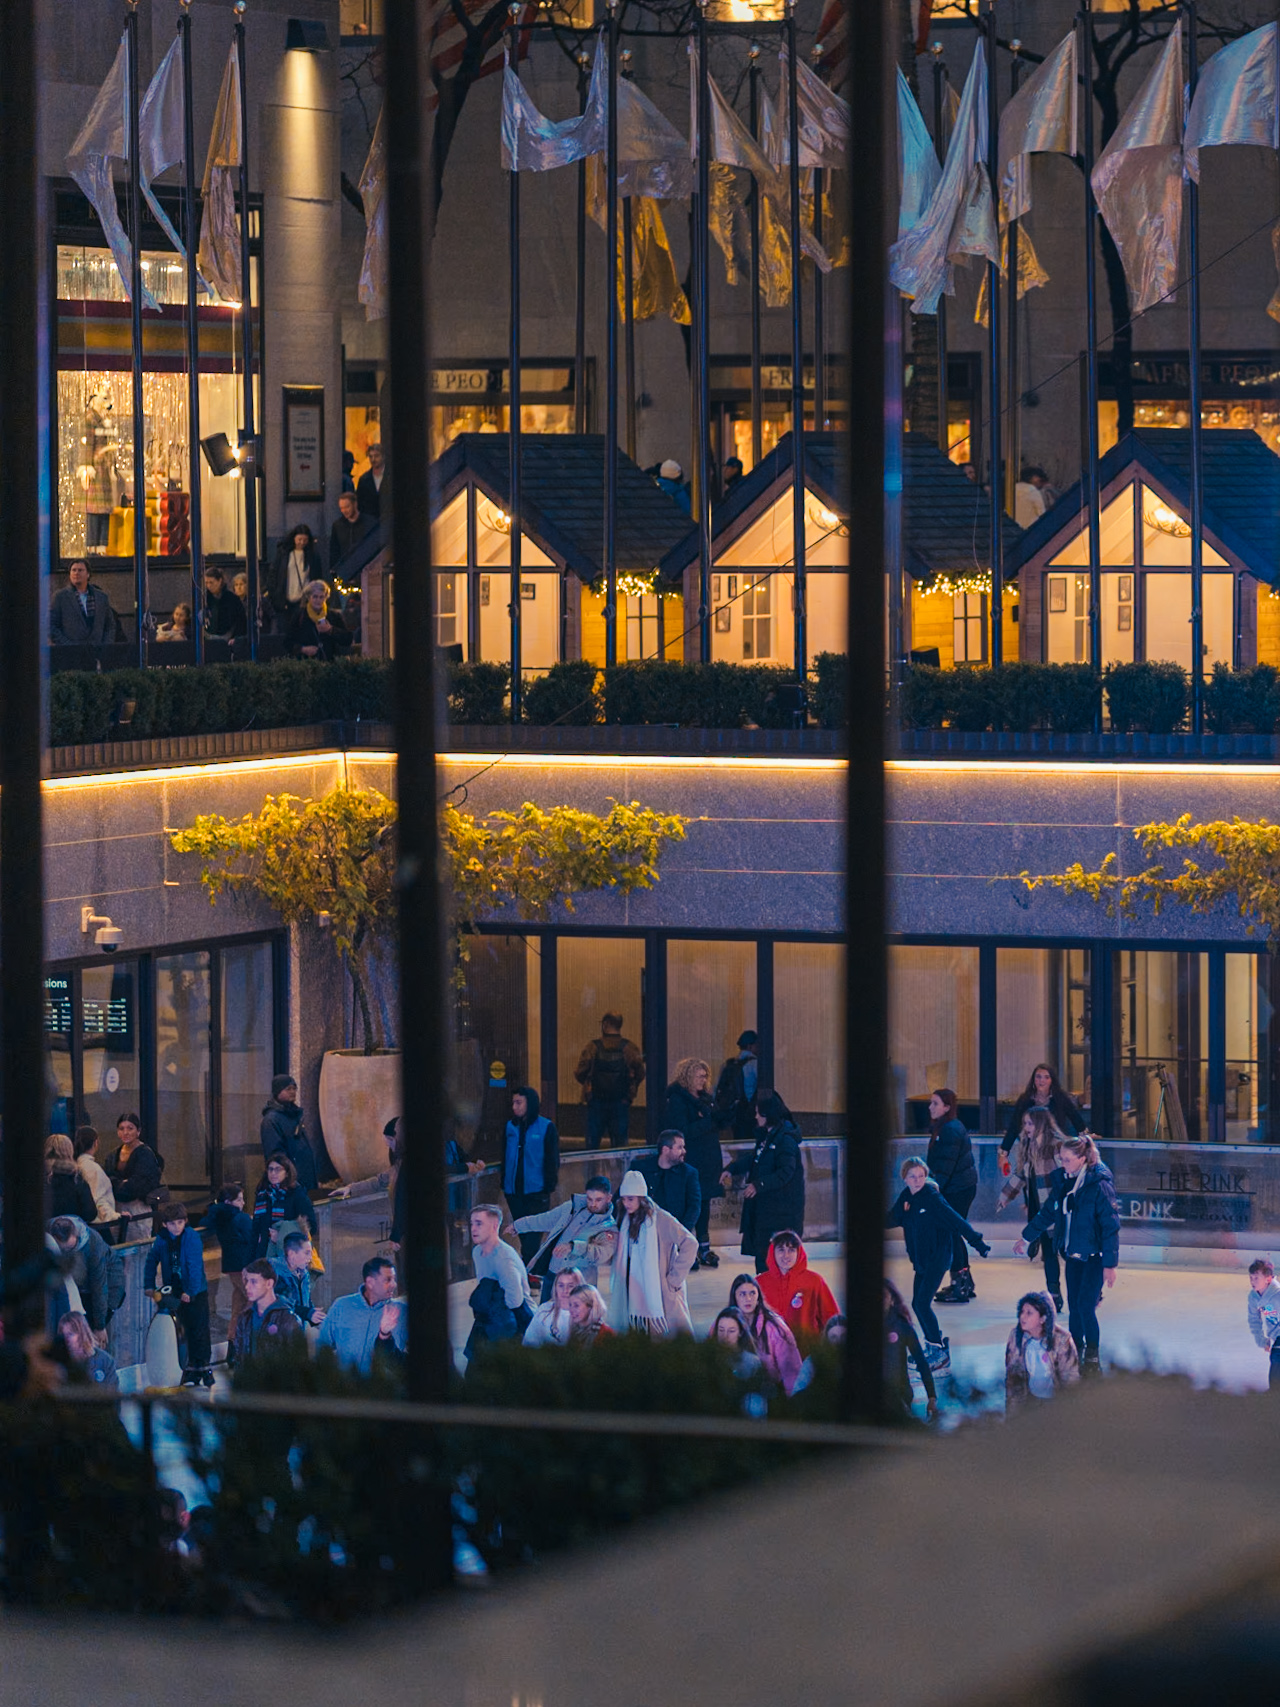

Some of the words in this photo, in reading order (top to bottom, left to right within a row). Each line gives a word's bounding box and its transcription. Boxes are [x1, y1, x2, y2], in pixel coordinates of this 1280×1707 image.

[1157, 1171, 1191, 1191] THE
[1200, 1172, 1245, 1193] RINK
[1130, 1200, 1175, 1219] RINK
